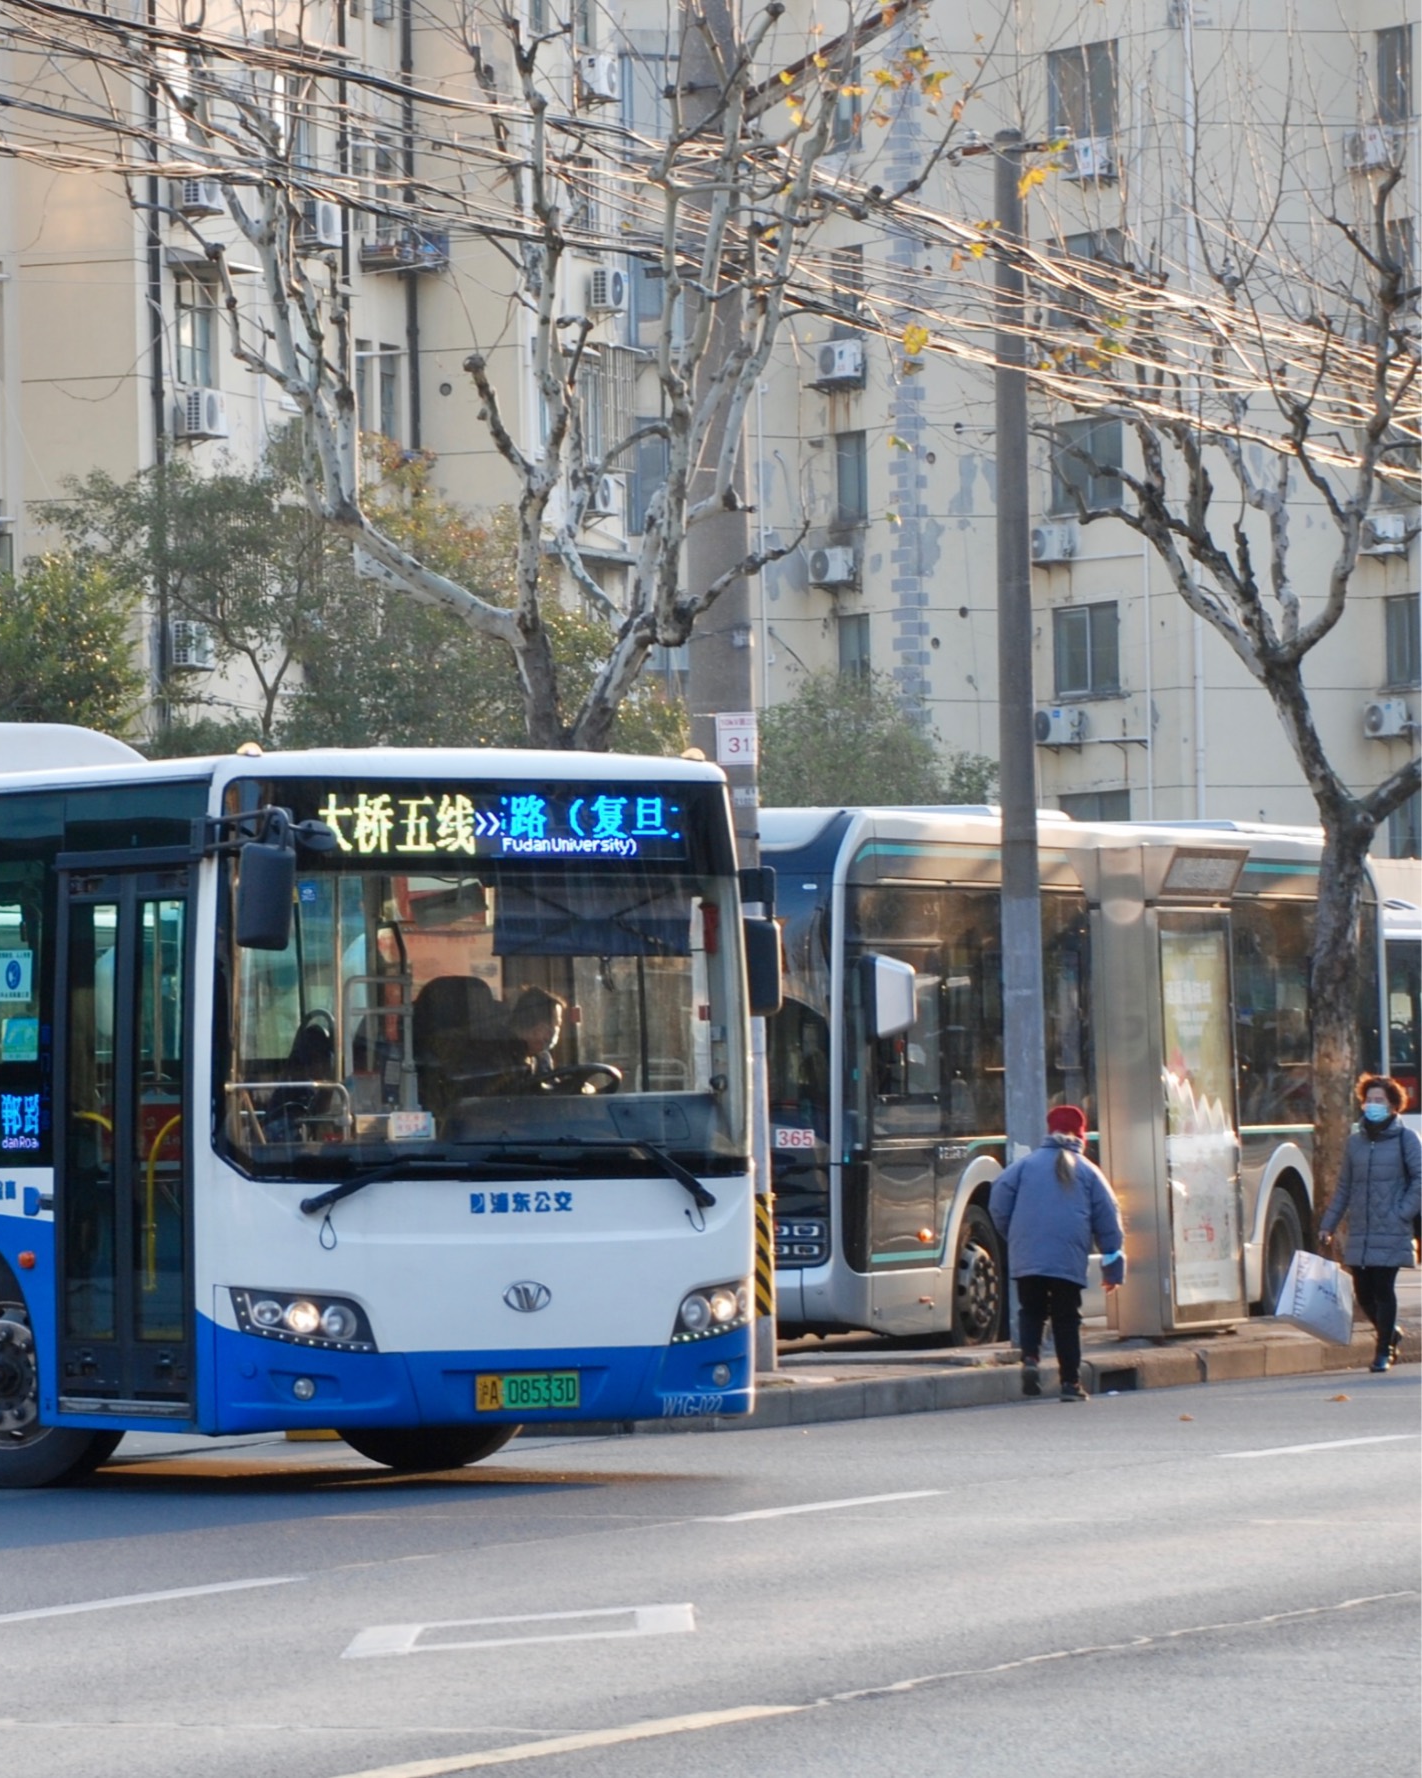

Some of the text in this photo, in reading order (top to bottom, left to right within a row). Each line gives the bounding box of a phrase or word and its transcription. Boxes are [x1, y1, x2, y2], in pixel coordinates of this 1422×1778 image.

[318, 793, 476, 855] 大桥五线
[2, 1136, 39, 1149] danRoa
[779, 1131, 812, 1146] 365
[490, 1191, 573, 1213] 浦东公交
